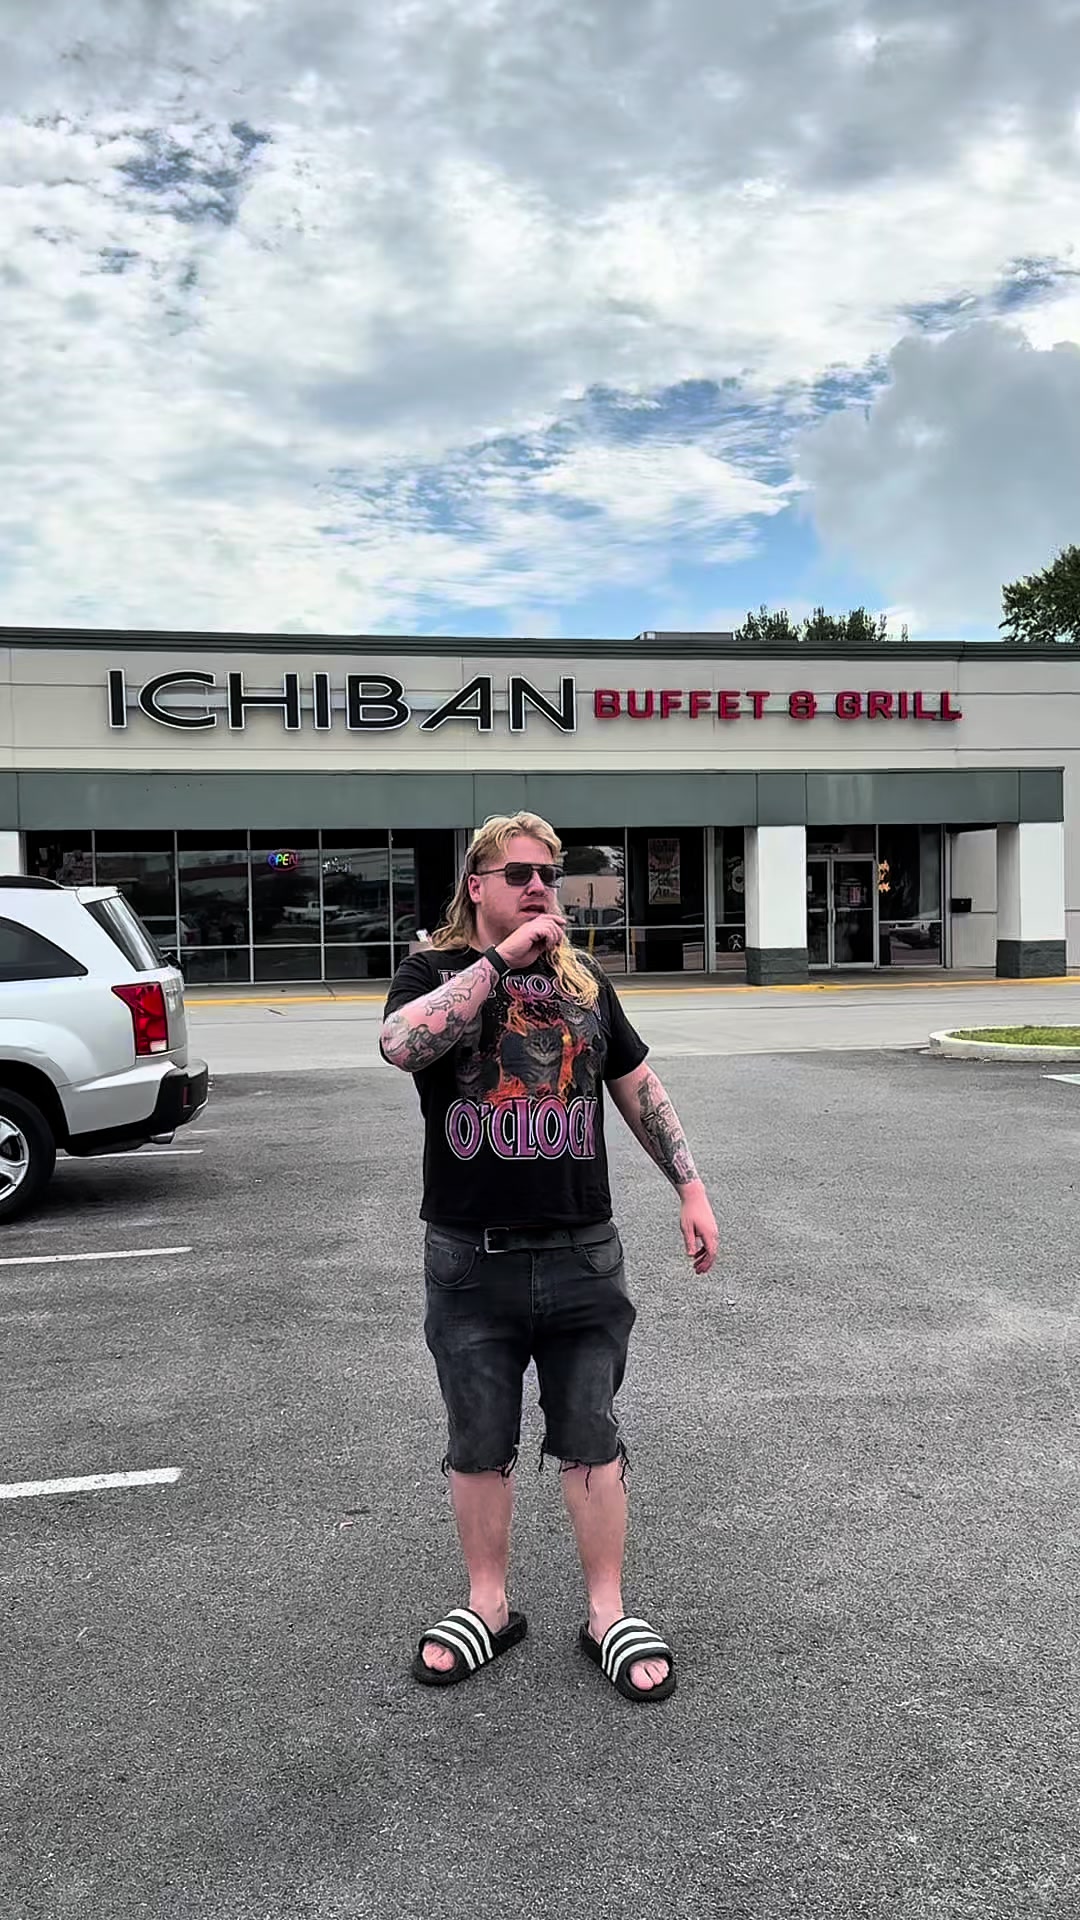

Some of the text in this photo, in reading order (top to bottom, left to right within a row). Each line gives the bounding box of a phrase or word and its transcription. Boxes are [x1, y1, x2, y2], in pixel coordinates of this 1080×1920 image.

[106, 668, 963, 733] ICHIBAN BUFFET & GRILL
[267, 852, 299, 867] OPEN
[445, 1095, 598, 1161] O'CLOCK
